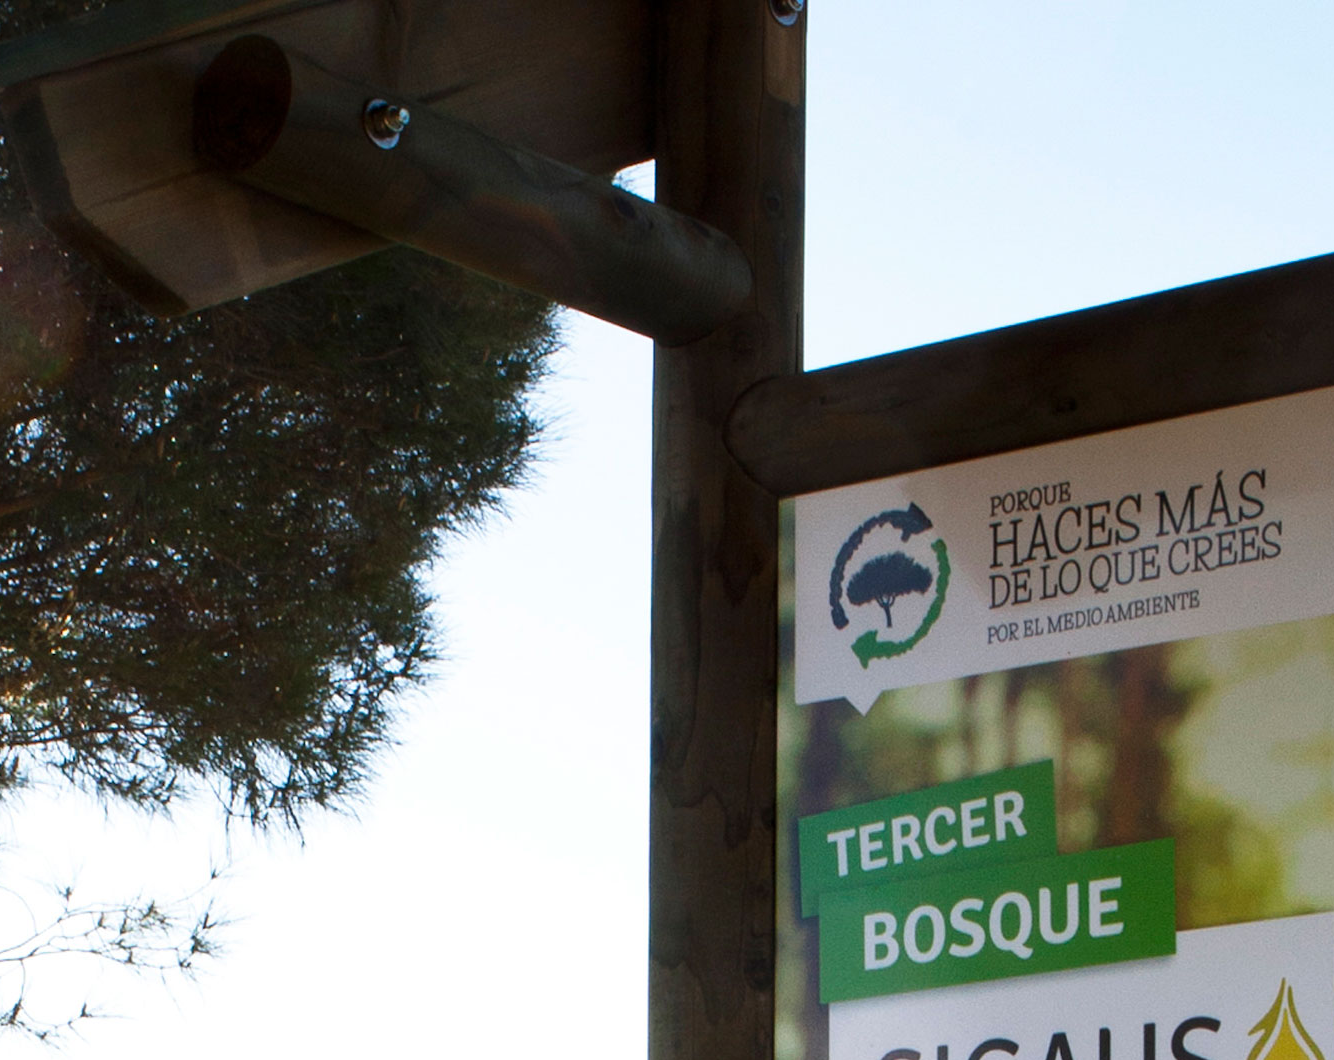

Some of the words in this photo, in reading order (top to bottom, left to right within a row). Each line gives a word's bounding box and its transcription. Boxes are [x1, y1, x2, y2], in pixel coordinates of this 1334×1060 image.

[988, 493, 1143, 567] HACES
[1154, 468, 1267, 538] MÁS
[990, 481, 1071, 517] PORQUE
[988, 567, 1033, 610] DE
[1039, 558, 1082, 601] LO
[1087, 543, 1161, 595] QUE
[1167, 520, 1283, 576] CREES
[987, 621, 1020, 645] POR
[1022, 617, 1045, 639] EL
[1046, 606, 1103, 635] MEDIO
[1104, 588, 1201, 624] AMBIENTE
[827, 791, 1027, 876] TERCER
[863, 877, 1124, 971] BOSQUE
